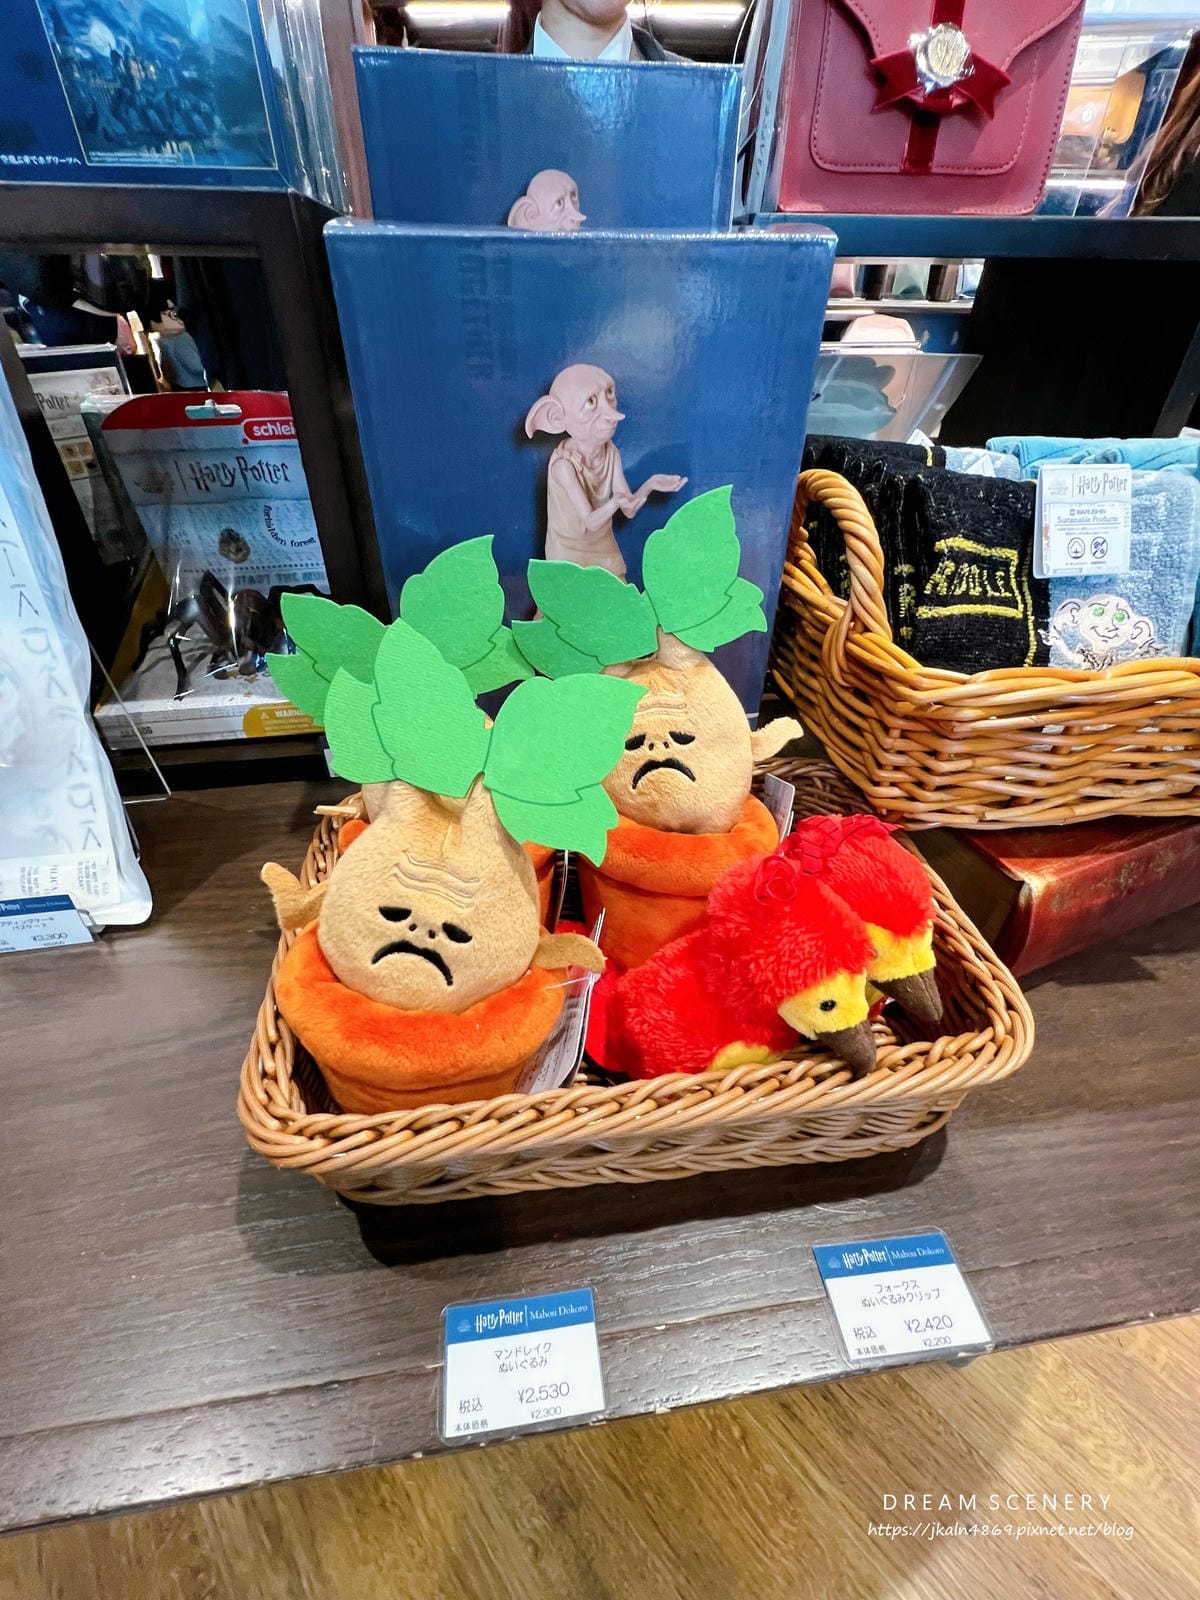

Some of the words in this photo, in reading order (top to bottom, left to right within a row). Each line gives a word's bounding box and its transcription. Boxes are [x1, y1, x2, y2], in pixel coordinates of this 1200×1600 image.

[189, 461, 237, 493] Harry
[235, 456, 290, 493] Potter
[1077, 474, 1102, 496] Harry
[1102, 473, 1128, 496] Potter
[264, 505, 287, 547] forbidden
[290, 536, 317, 547] forest
[1092, 515, 1118, 523] Products
[842, 1251, 864, 1270] Harry
[861, 1248, 887, 1266] Potter
[891, 1249, 917, 1260] Mahou
[916, 1246, 945, 1257] Dokoro
[861, 1288, 940, 1308] ぬいぐるみクリップ
[874, 1279, 920, 1295] フォークス
[474, 1313, 499, 1334] Harry
[498, 1308, 524, 1329] Potter
[530, 1308, 557, 1321] Mahou
[558, 1303, 589, 1316] Dokoro
[853, 1325, 877, 1340] 税込
[904, 1314, 953, 1334] ¥2,420
[494, 1342, 552, 1360] マンドレイク
[855, 1344, 887, 1356] 本体価格
[922, 1336, 952, 1347] ¥2,200
[498, 1356, 549, 1373] ぬいぐるみ
[459, 1397, 484, 1415] 税込
[517, 1381, 570, 1405] ¥2,530
[454, 1418, 489, 1433] 本体価格
[530, 1405, 562, 1420] ¥2,300
